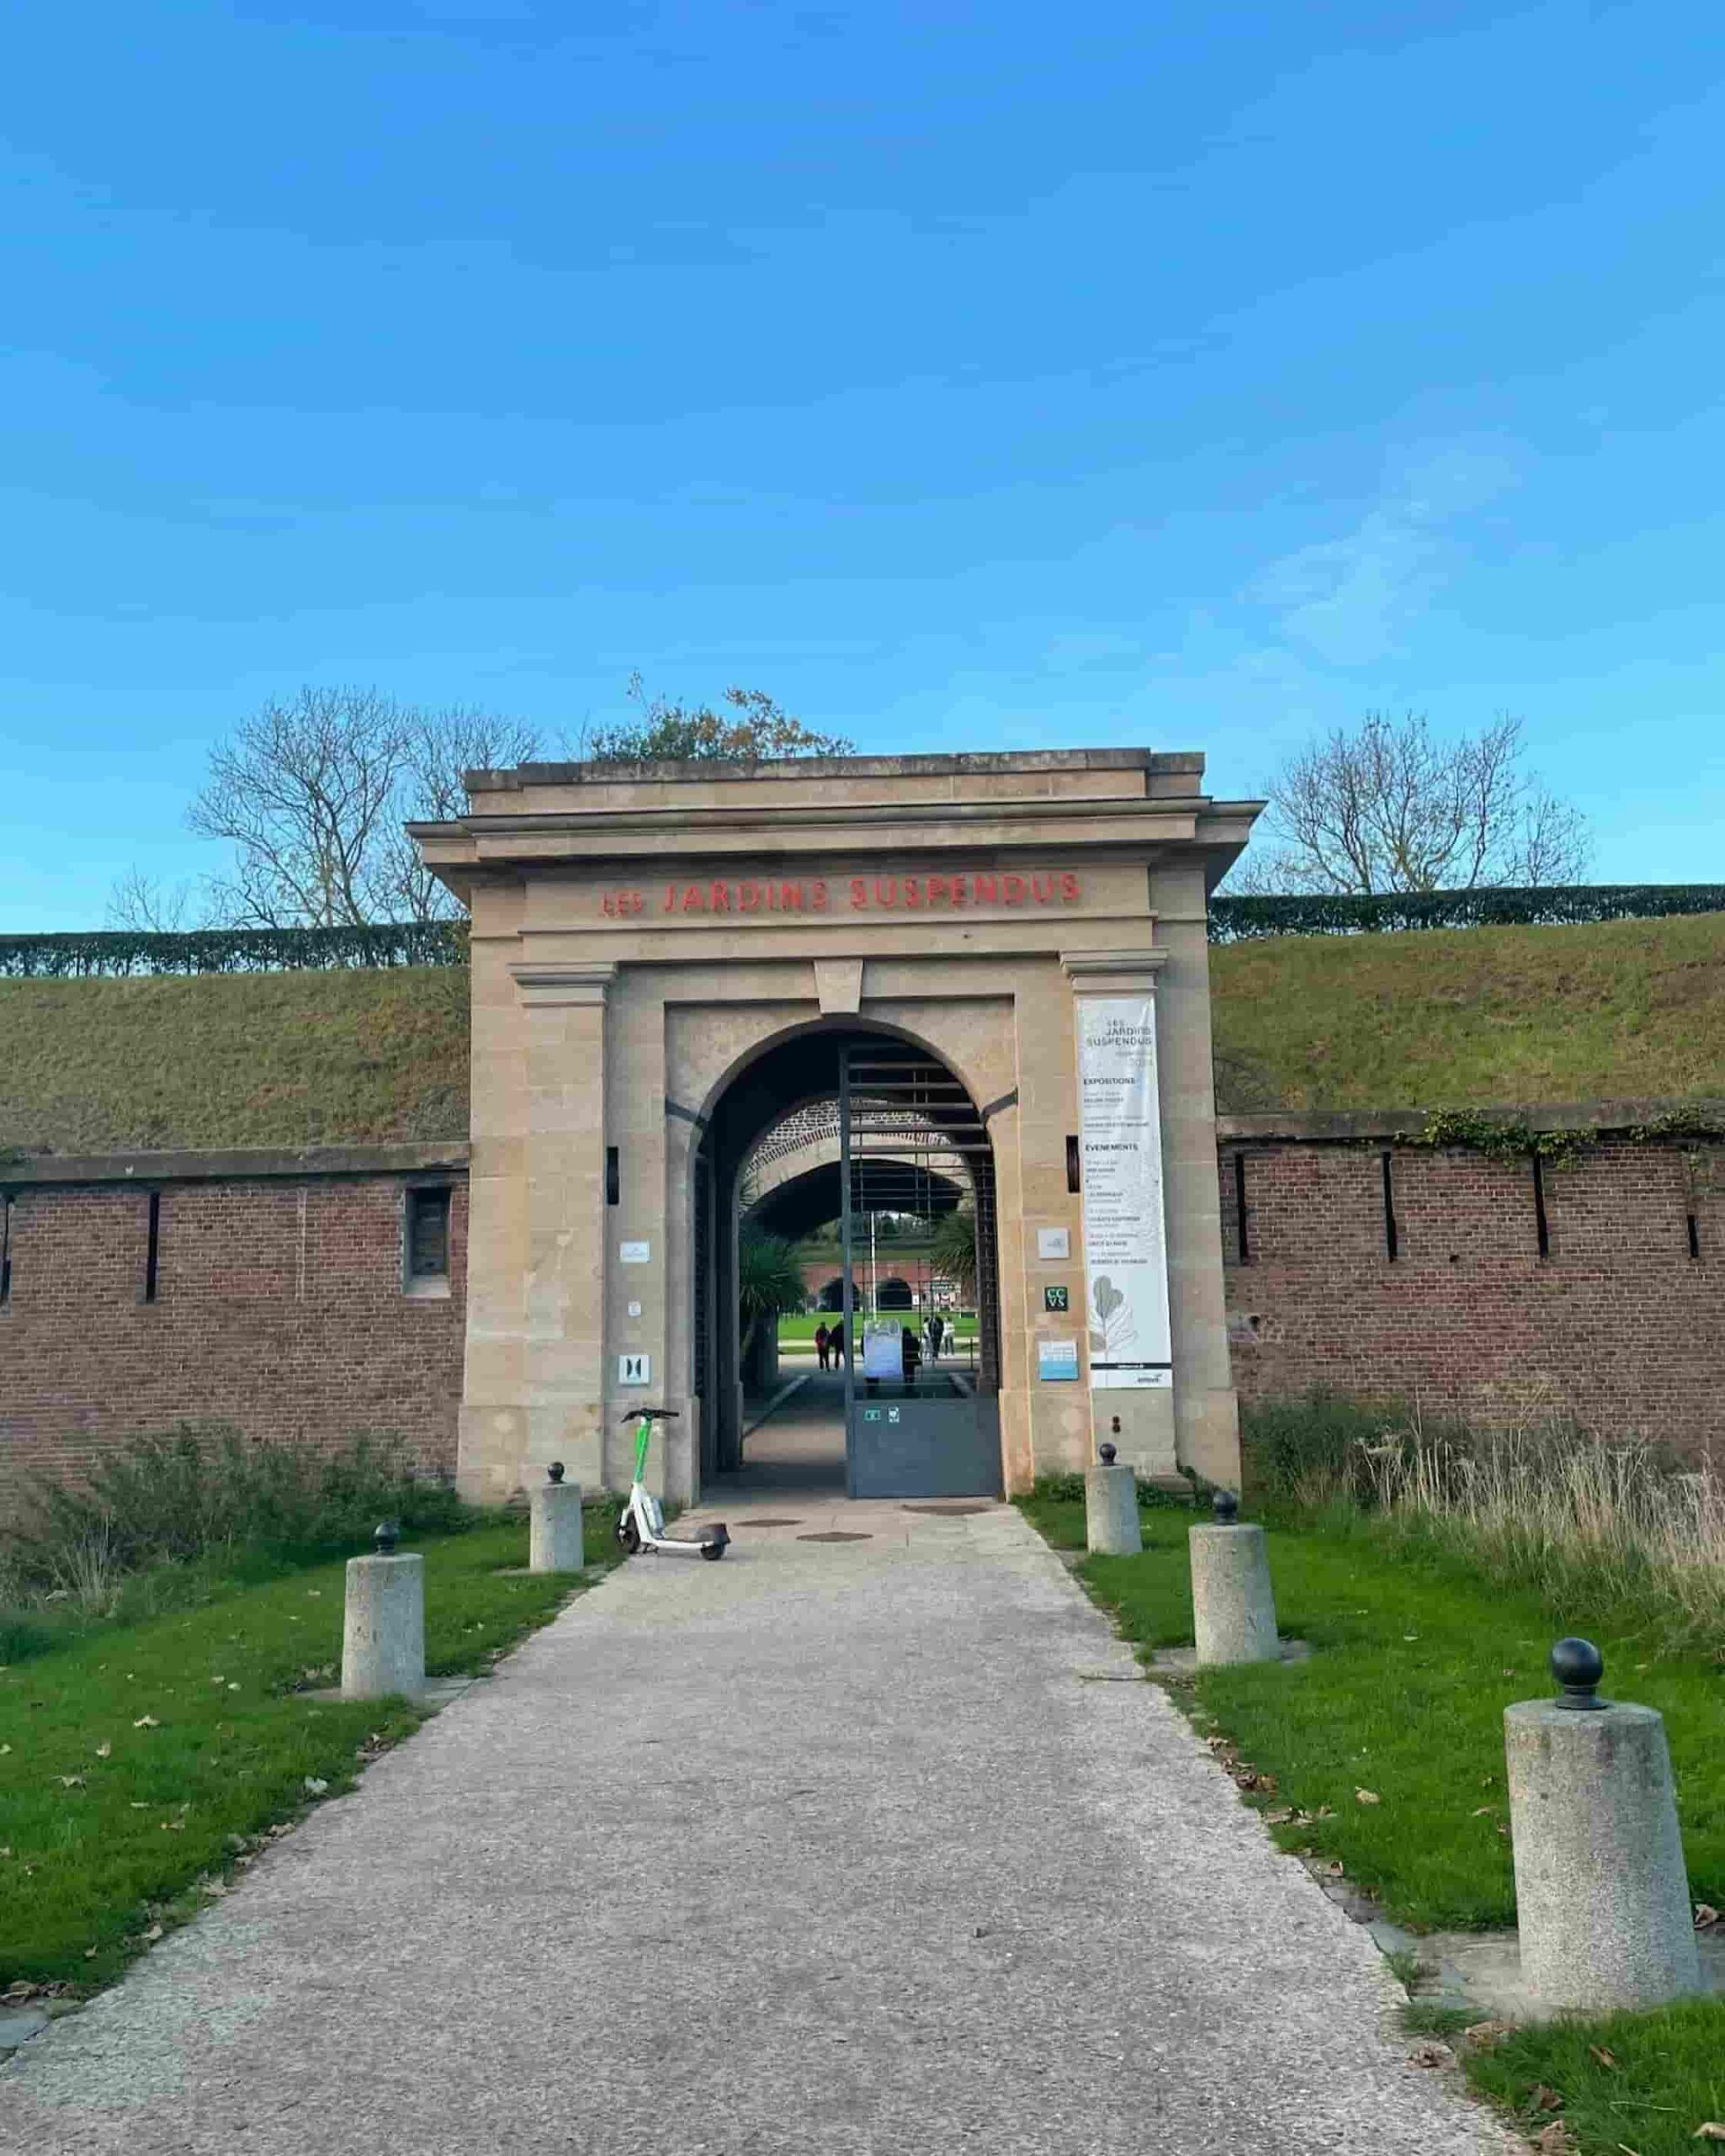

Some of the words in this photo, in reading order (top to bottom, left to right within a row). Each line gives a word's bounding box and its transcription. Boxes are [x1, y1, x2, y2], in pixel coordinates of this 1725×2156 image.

[600, 891, 644, 916] LES
[665, 881, 827, 912] JARDINS
[849, 873, 1081, 910] SUSPENDUS
